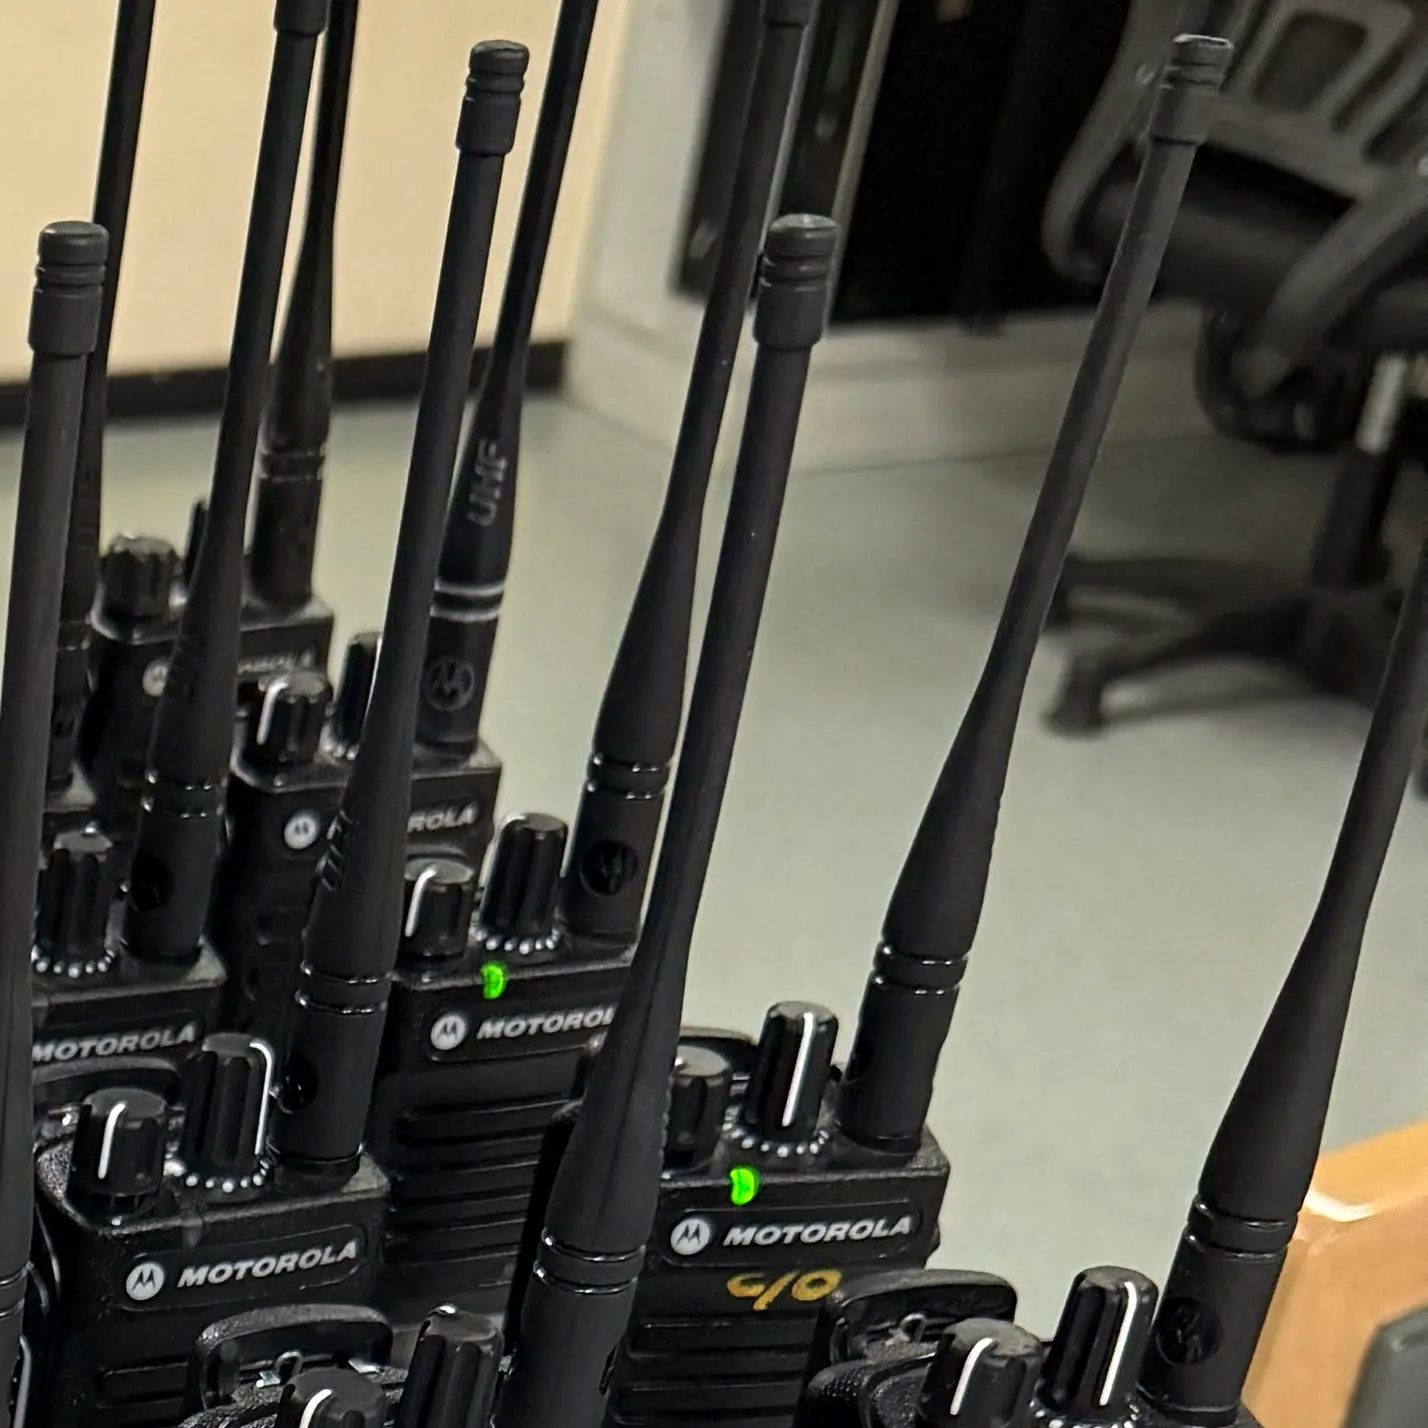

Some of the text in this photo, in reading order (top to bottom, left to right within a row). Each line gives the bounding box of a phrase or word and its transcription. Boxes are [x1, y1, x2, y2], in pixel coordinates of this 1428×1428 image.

[407, 802, 481, 833] ROLA
[476, 1002, 616, 1039] MOTOROL
[32, 1022, 195, 1062] MOTOROLA
[723, 1215, 911, 1247] MOTOROLA
[176, 1238, 358, 1290] MOTOROLA
